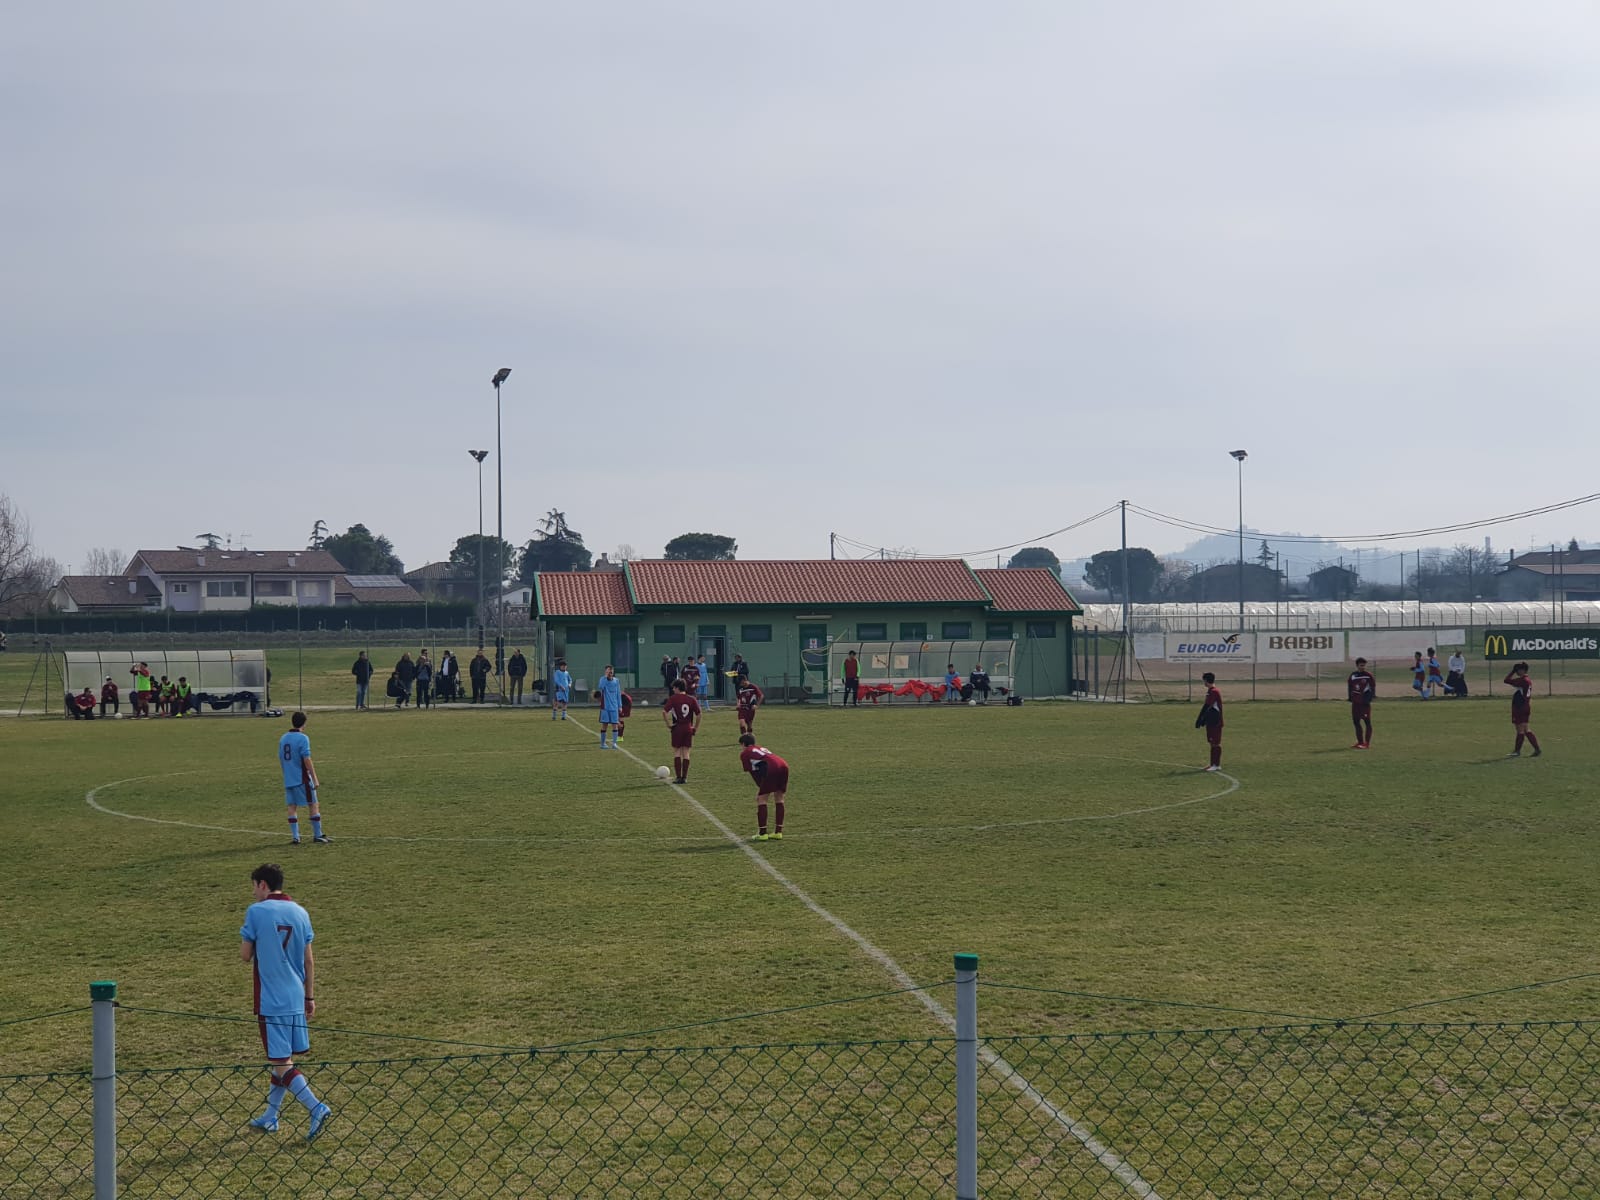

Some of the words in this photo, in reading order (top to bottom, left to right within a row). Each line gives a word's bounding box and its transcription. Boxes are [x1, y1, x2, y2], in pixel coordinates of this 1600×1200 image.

[1177, 643, 1241, 653] EURODIF
[1269, 636, 1333, 649] BABBI
[1512, 638, 1597, 651] McDonald's
[681, 704, 690, 718] 9
[283, 744, 292, 761] 8
[277, 925, 293, 950] 7
